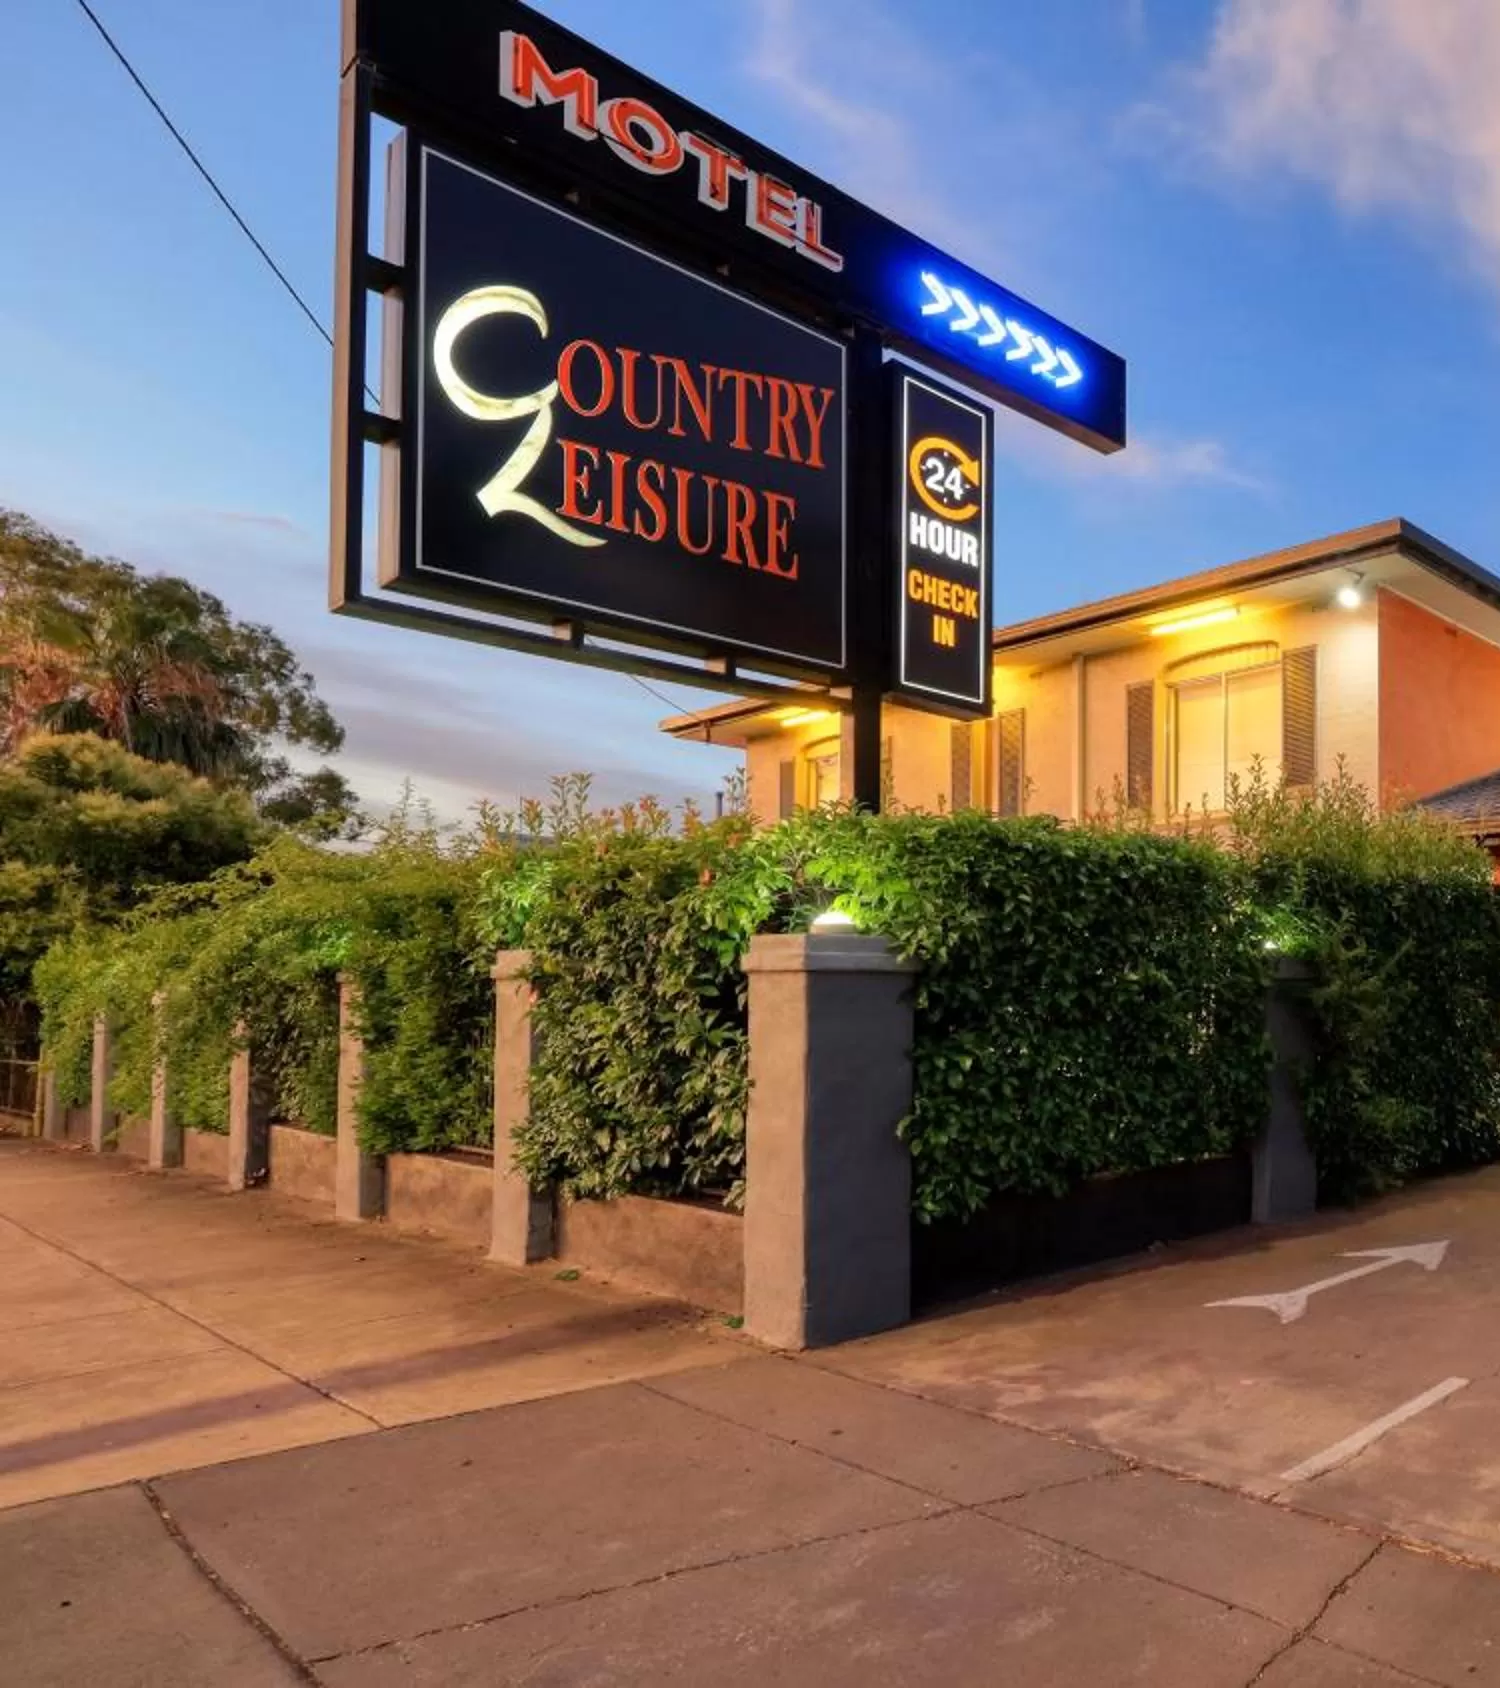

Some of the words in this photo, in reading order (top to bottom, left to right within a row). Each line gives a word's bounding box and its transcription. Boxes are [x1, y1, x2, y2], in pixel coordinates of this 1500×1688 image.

[499, 30, 843, 273] MOTEL
[433, 285, 835, 470] COUNTRY
[475, 402, 799, 580] LEISURE
[924, 456, 966, 501] 24
[910, 511, 979, 567] HOUR
[908, 569, 979, 618] CHECK
[932, 615, 956, 647] IN
